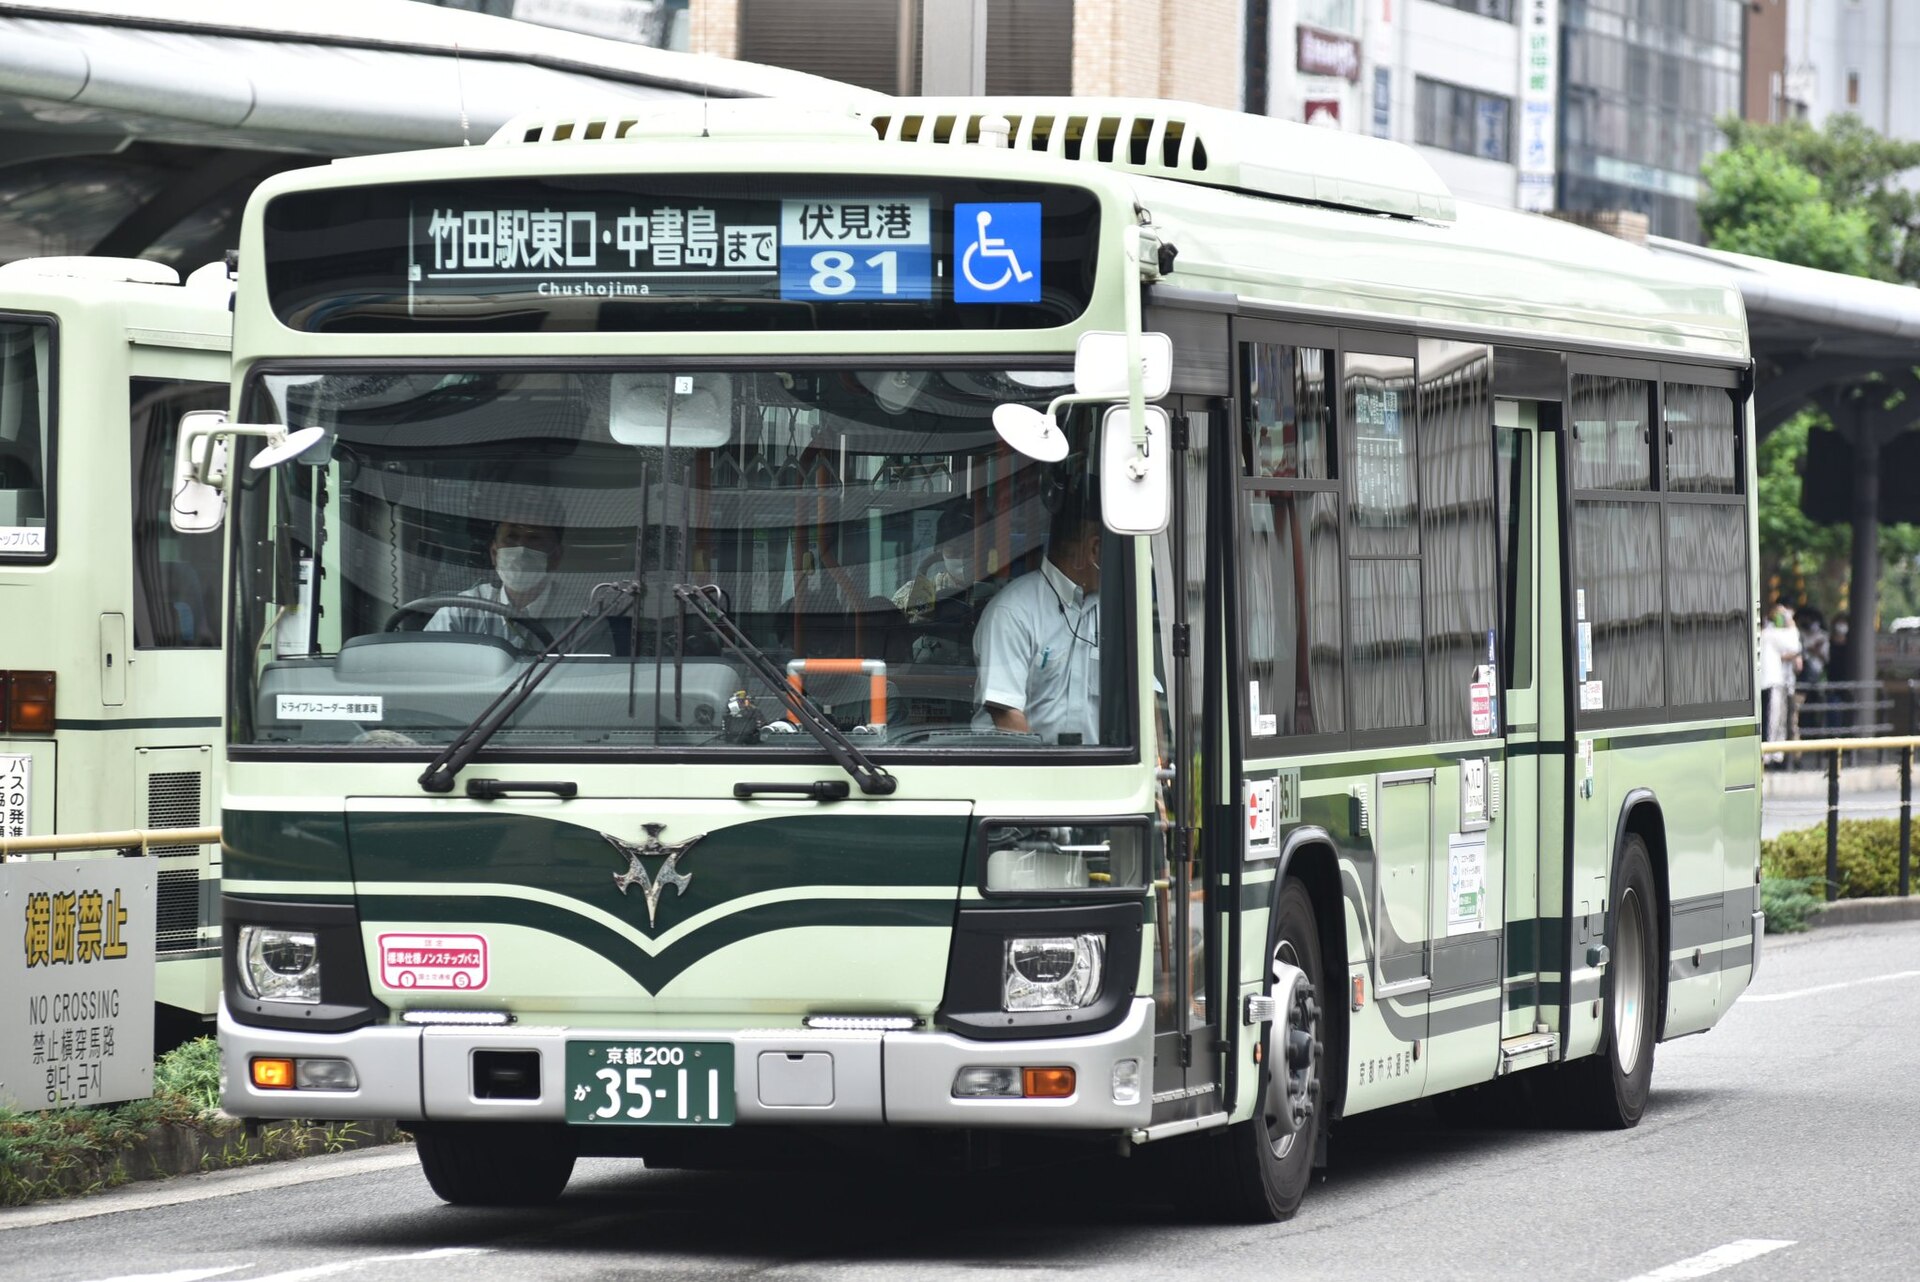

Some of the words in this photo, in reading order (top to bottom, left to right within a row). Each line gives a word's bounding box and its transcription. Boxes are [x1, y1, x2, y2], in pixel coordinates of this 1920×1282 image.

[798, 203, 911, 240] 伏見港
[538, 281, 650, 298] Chushojima
[809, 251, 897, 296] 81
[24, 888, 127, 968] 横断禁止
[29, 995, 48, 1025] NO
[53, 989, 119, 1023] CROSSING
[574, 1084, 591, 1101] か
[595, 1068, 719, 1120] 35-11
